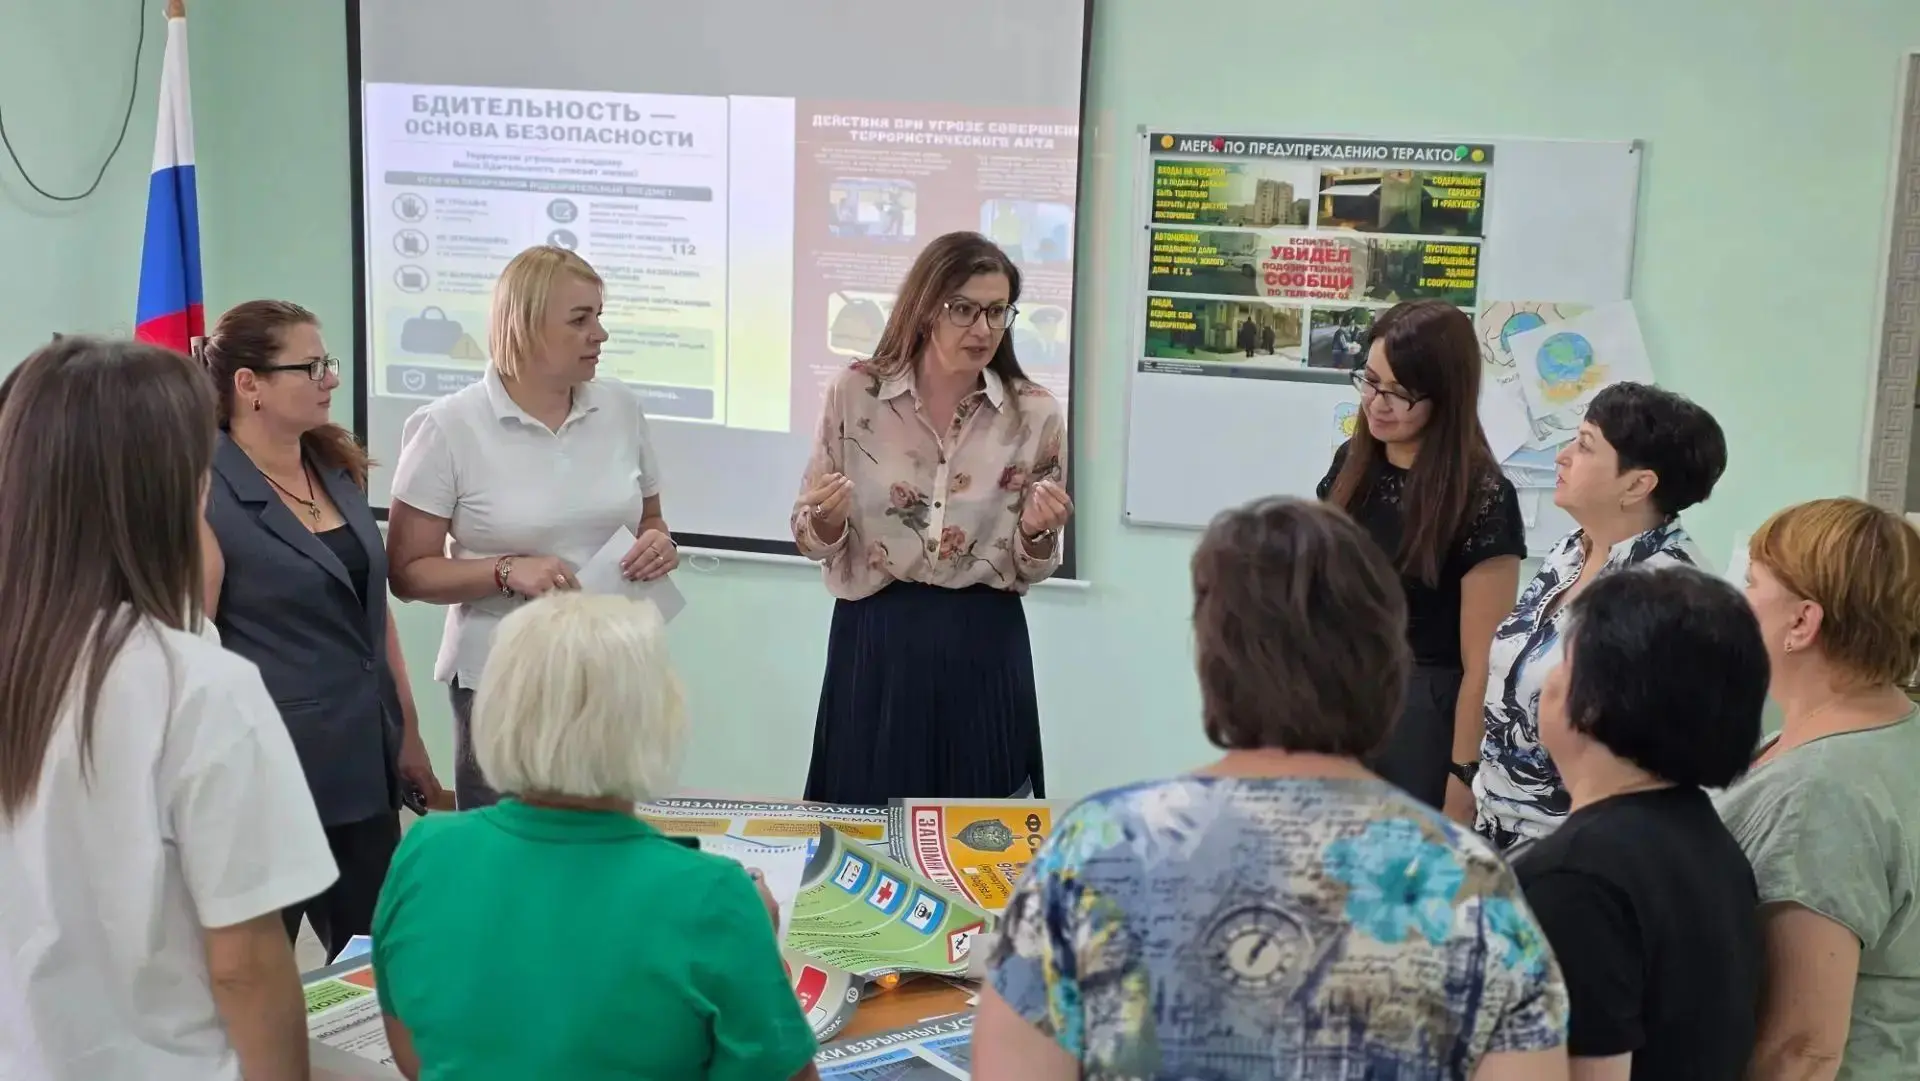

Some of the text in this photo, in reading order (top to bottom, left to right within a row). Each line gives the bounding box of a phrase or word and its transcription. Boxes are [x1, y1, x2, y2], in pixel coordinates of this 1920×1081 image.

[411, 94, 641, 123] БДИТЕЛЬНОСТЬ
[404, 119, 695, 149] ОСНОВА БЕЗОПАСНОСТИ
[812, 114, 890, 130] ДЕЙСТВИЯ
[894, 118, 924, 131] ПРИ
[928, 119, 984, 134] УГРОЗЕ
[849, 130, 1055, 150] ТЕРРОРИСТИЧЕСКОГО АКТА
[1224, 140, 1245, 154] ПО
[1249, 142, 1388, 160] ПРЕДУПРЕЖДЕНИЮ
[670, 243, 697, 257] 112
[1289, 237, 1334, 247] ЕСЛИ ТЫ
[1270, 246, 1352, 264] УВИДЕЛ
[1264, 271, 1354, 291] СООБЩИ
[1267, 288, 1282, 297] ПО
[1284, 288, 1336, 299] ТЕЛЕФОНУ
[655, 799, 788, 811] ОБЯЗАННОСТИ
[918, 818, 945, 872] ЗАПОМНИ
[845, 1024, 949, 1054] ВЗРЫВНЫХ
